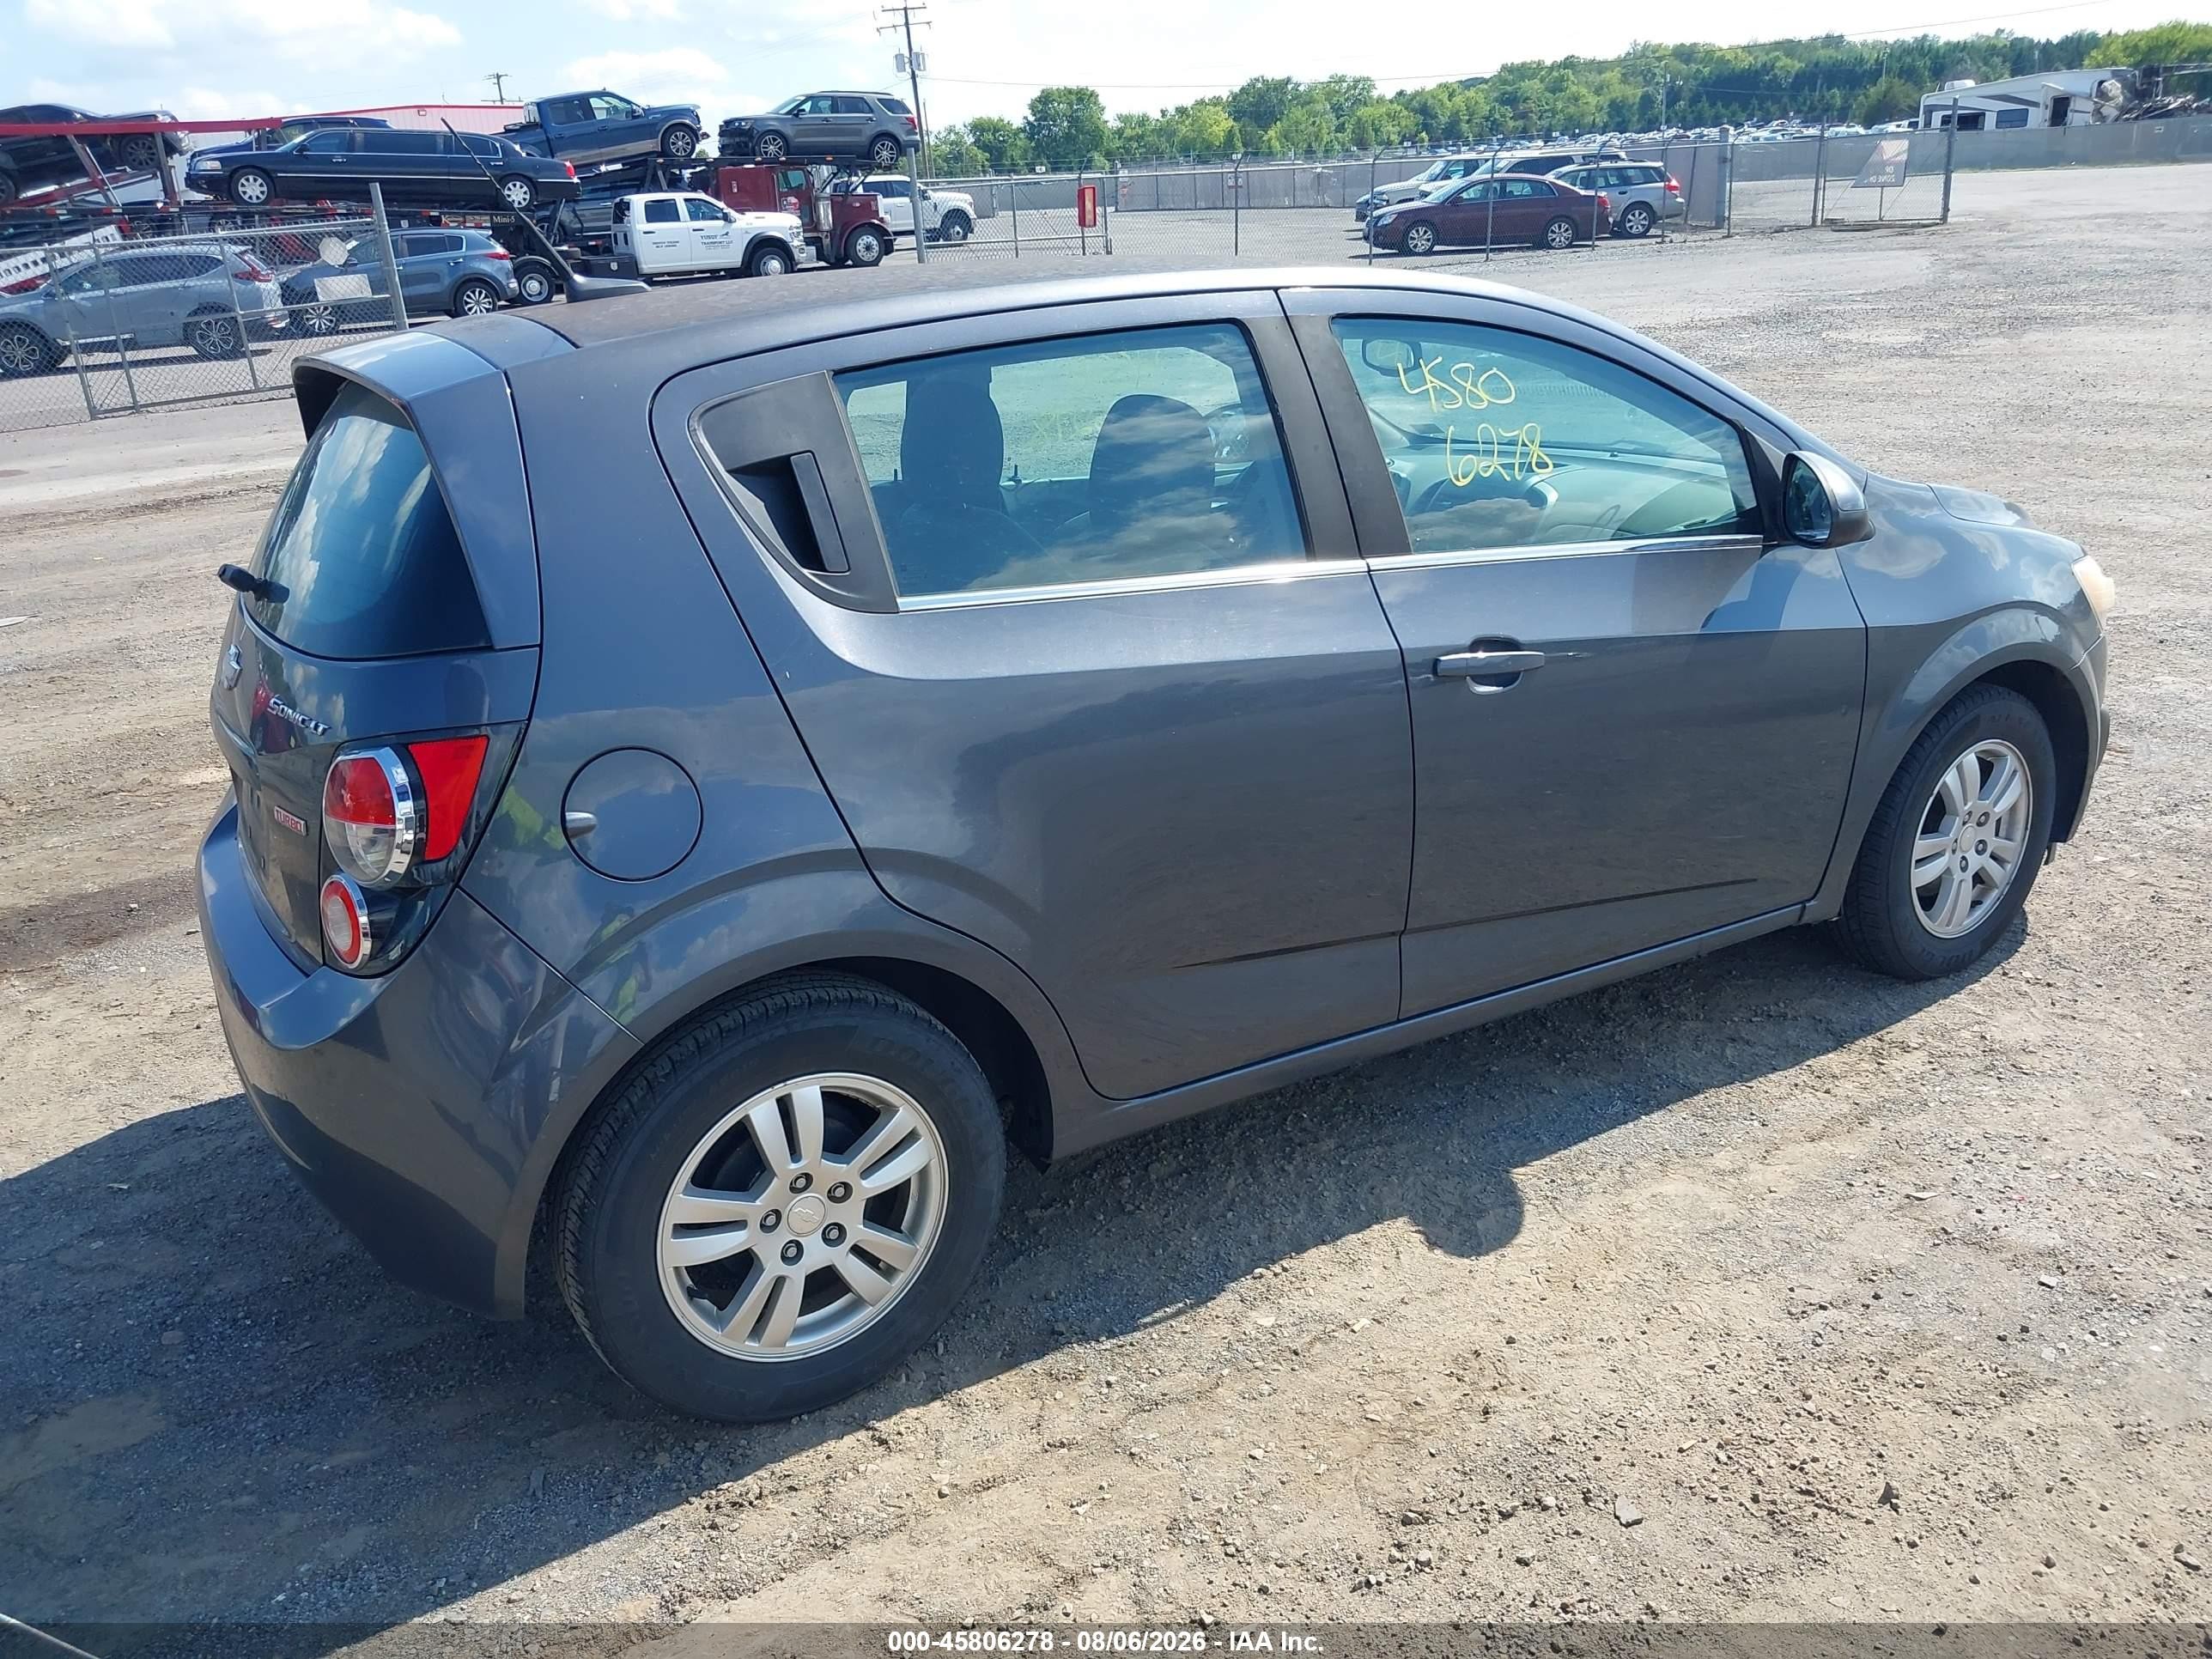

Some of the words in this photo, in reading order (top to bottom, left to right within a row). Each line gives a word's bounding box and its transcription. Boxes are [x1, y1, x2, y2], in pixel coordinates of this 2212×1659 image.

[493, 215, 515, 224] Mini-5
[1396, 356, 1516, 412] 4580
[1446, 422, 1553, 487] 6278
[309, 720, 331, 736] LT
[275, 807, 305, 834] TURBO
